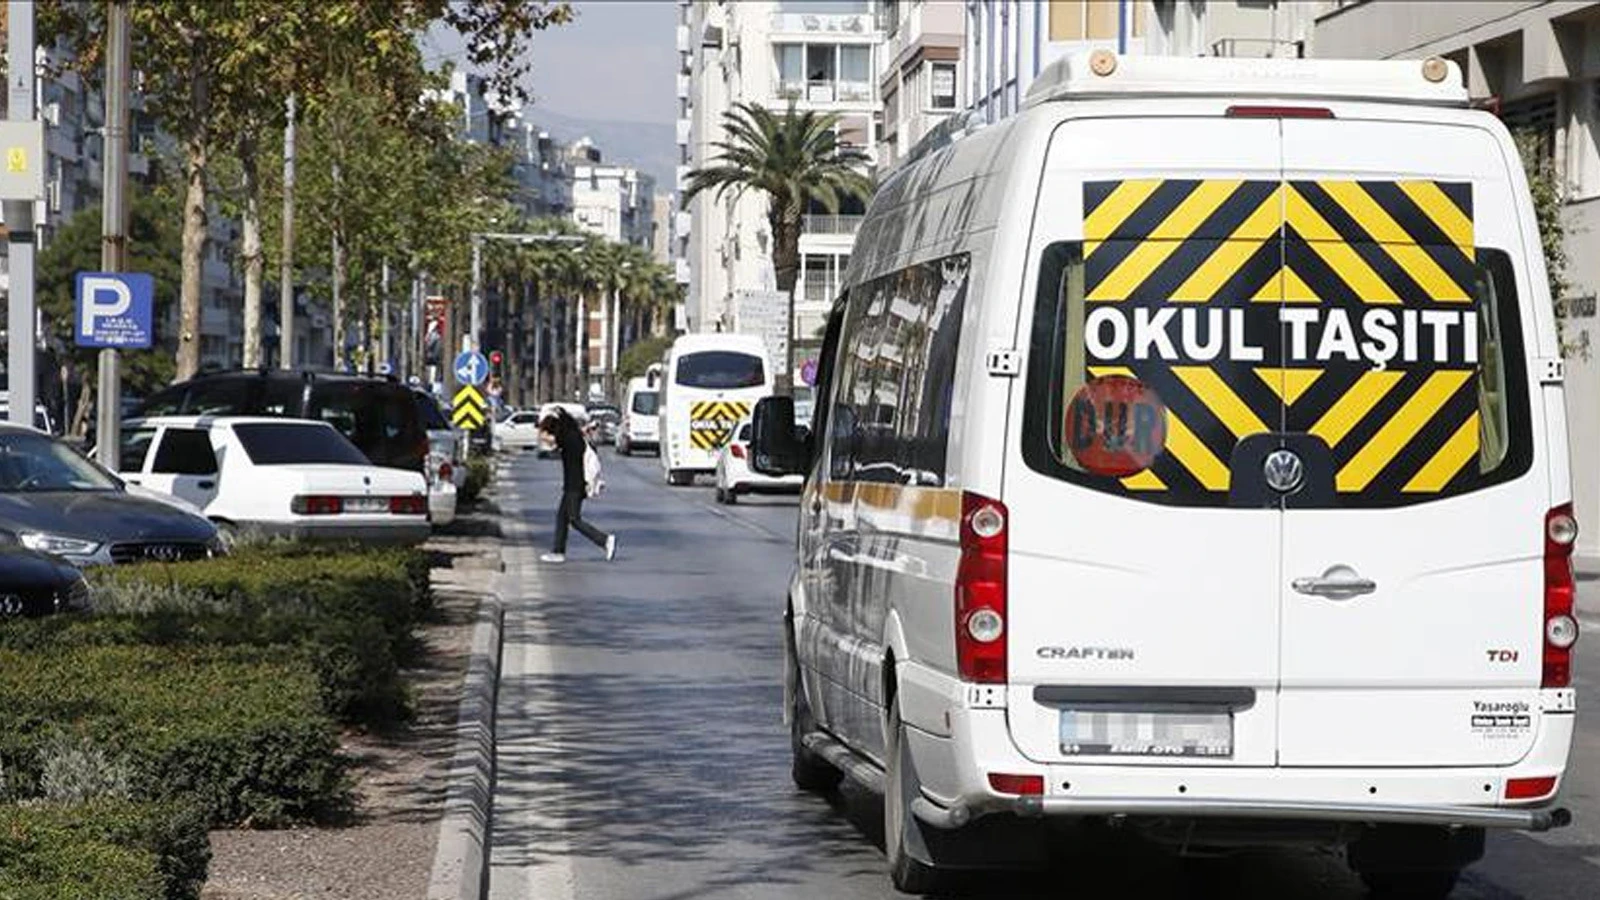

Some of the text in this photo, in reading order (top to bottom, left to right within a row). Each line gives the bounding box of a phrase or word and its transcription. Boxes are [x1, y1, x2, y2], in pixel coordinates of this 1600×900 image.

[82, 276, 131, 336] P
[1084, 307, 1479, 371] OKUL TAŞITI
[1073, 398, 1158, 450] DUR
[1036, 646, 1134, 660] CRAFTER
[1486, 649, 1519, 662] TDI
